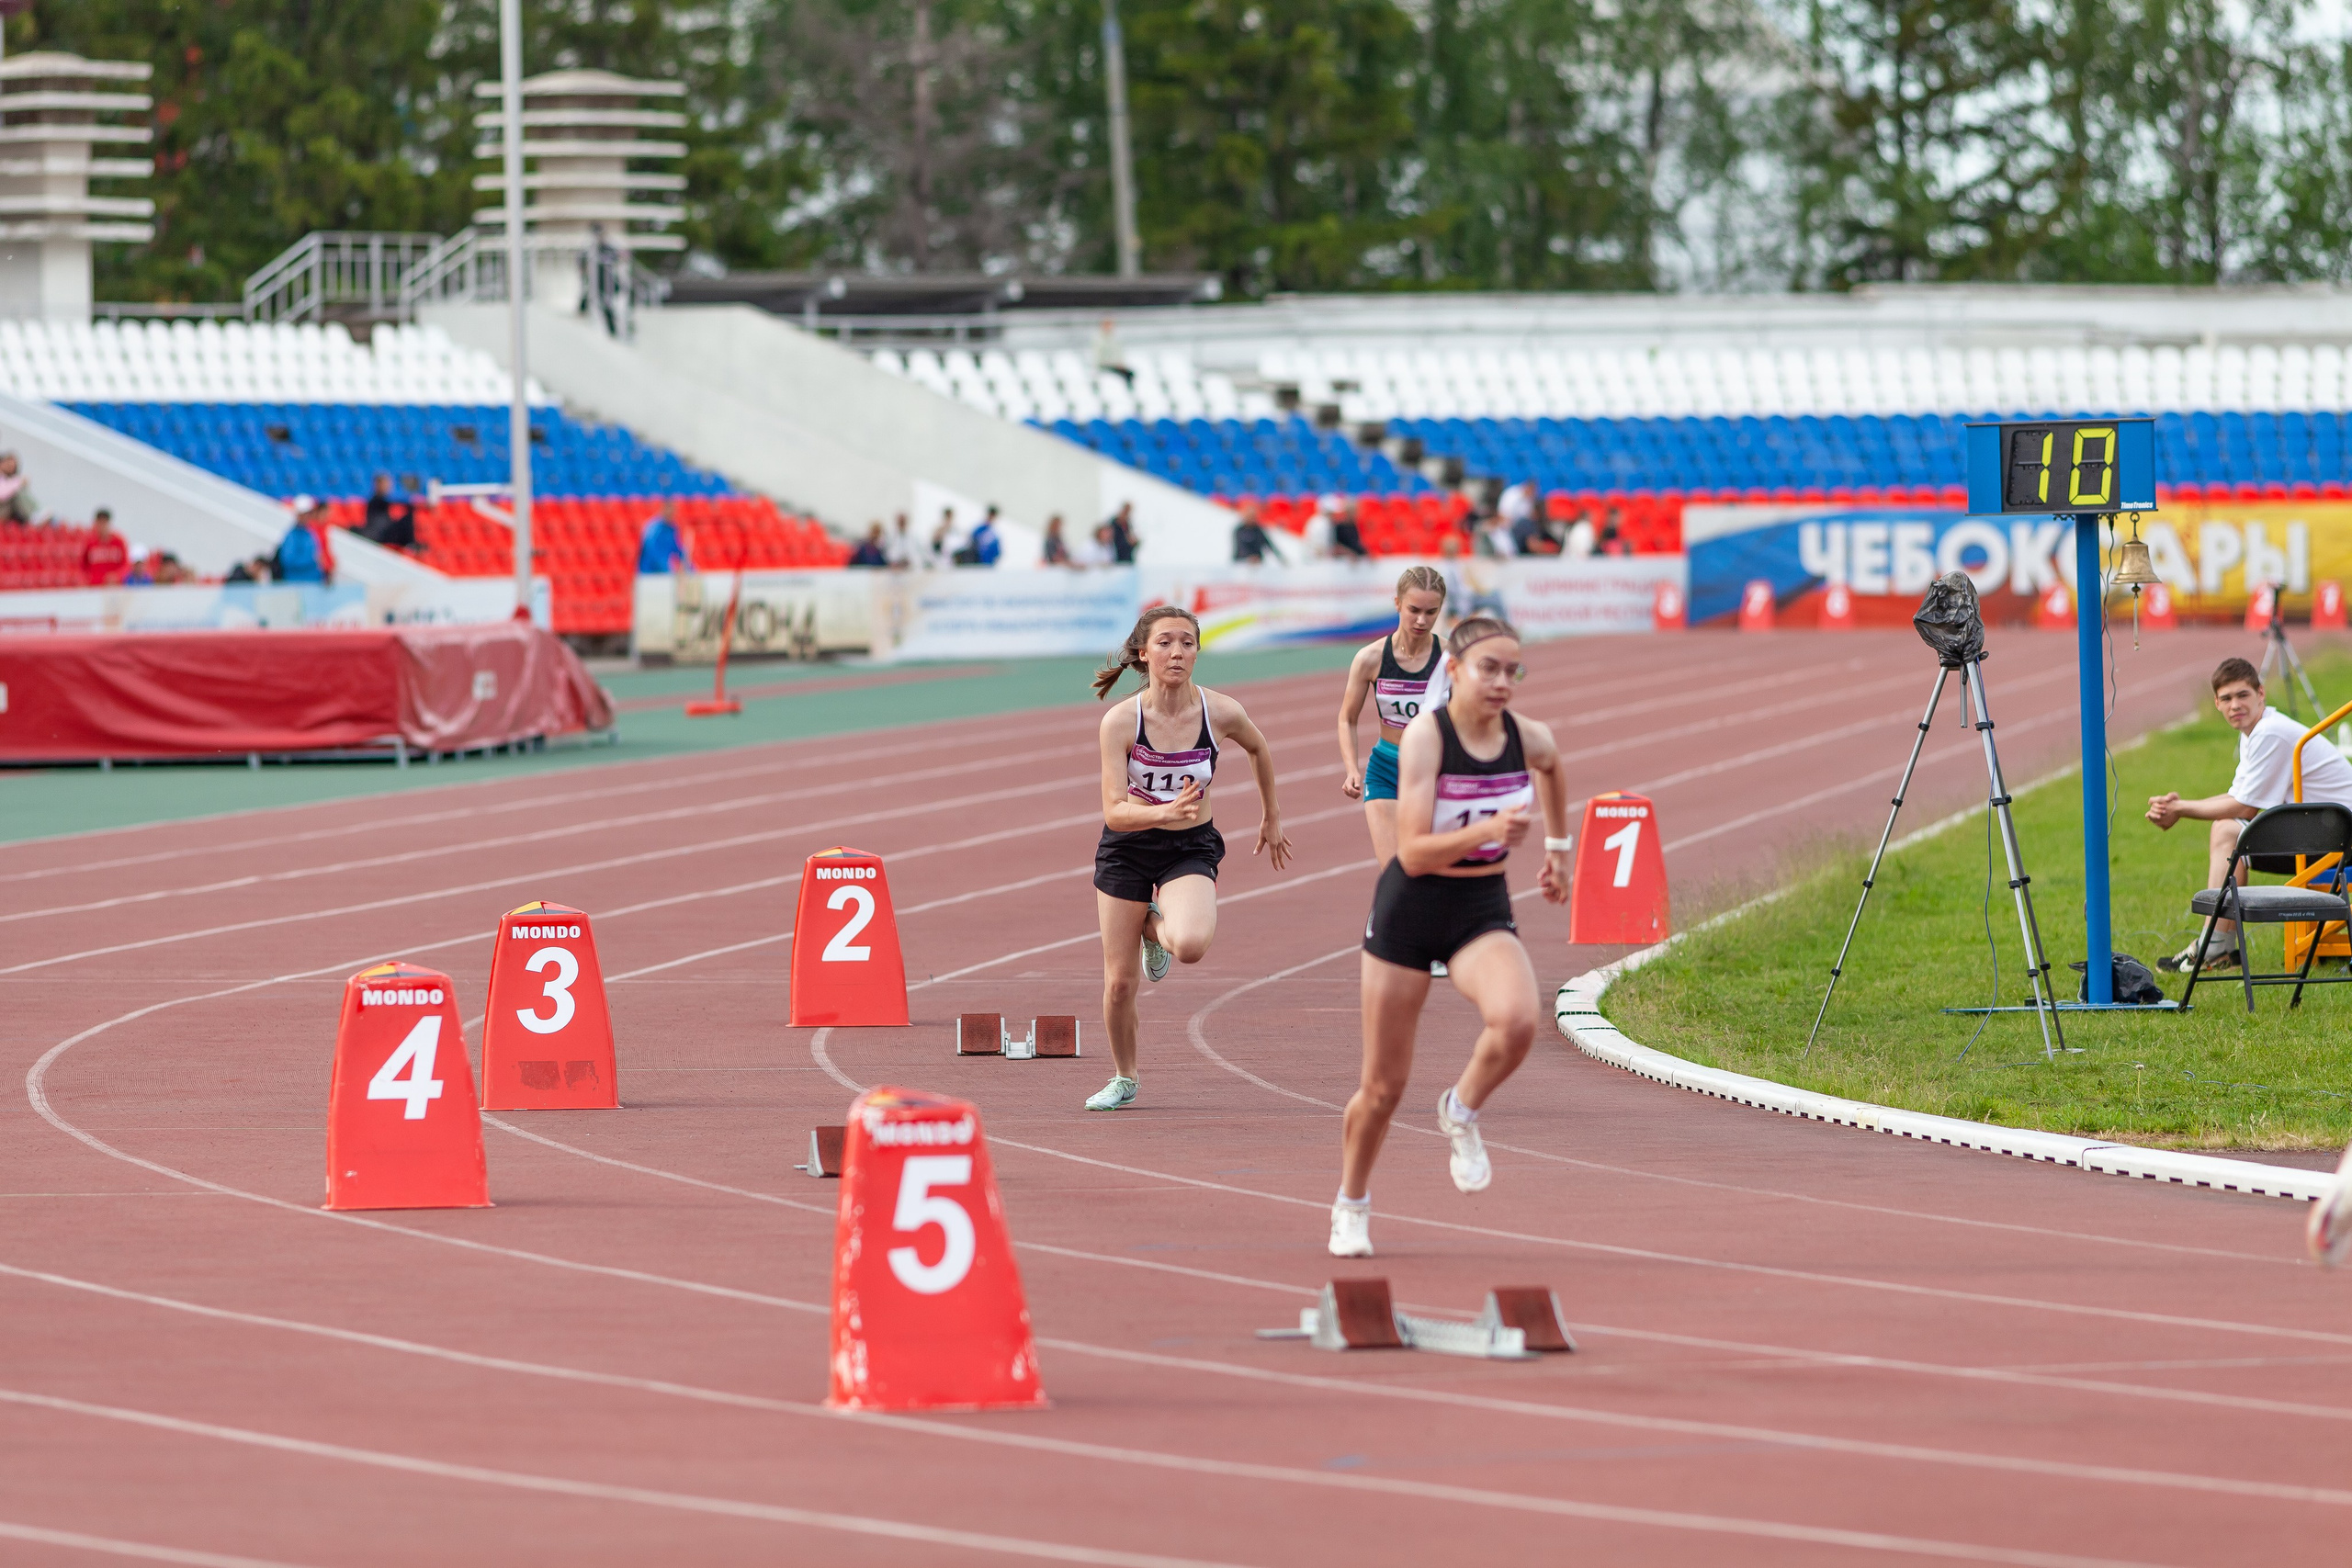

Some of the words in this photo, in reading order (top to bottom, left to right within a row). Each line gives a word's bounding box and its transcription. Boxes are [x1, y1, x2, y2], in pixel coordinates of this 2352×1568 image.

[2038, 427, 2116, 505] 10
[1595, 806, 1648, 818] MONDO
[816, 867, 876, 880] MONDO
[1603, 820, 1641, 887] 1
[512, 925, 581, 940] MONDO
[821, 885, 876, 962] 2
[362, 989, 444, 1006] MONDO
[515, 946, 579, 1034] 3
[367, 1015, 444, 1120] 4
[874, 1121, 974, 1146] MONDO
[888, 1155, 976, 1294] 5
